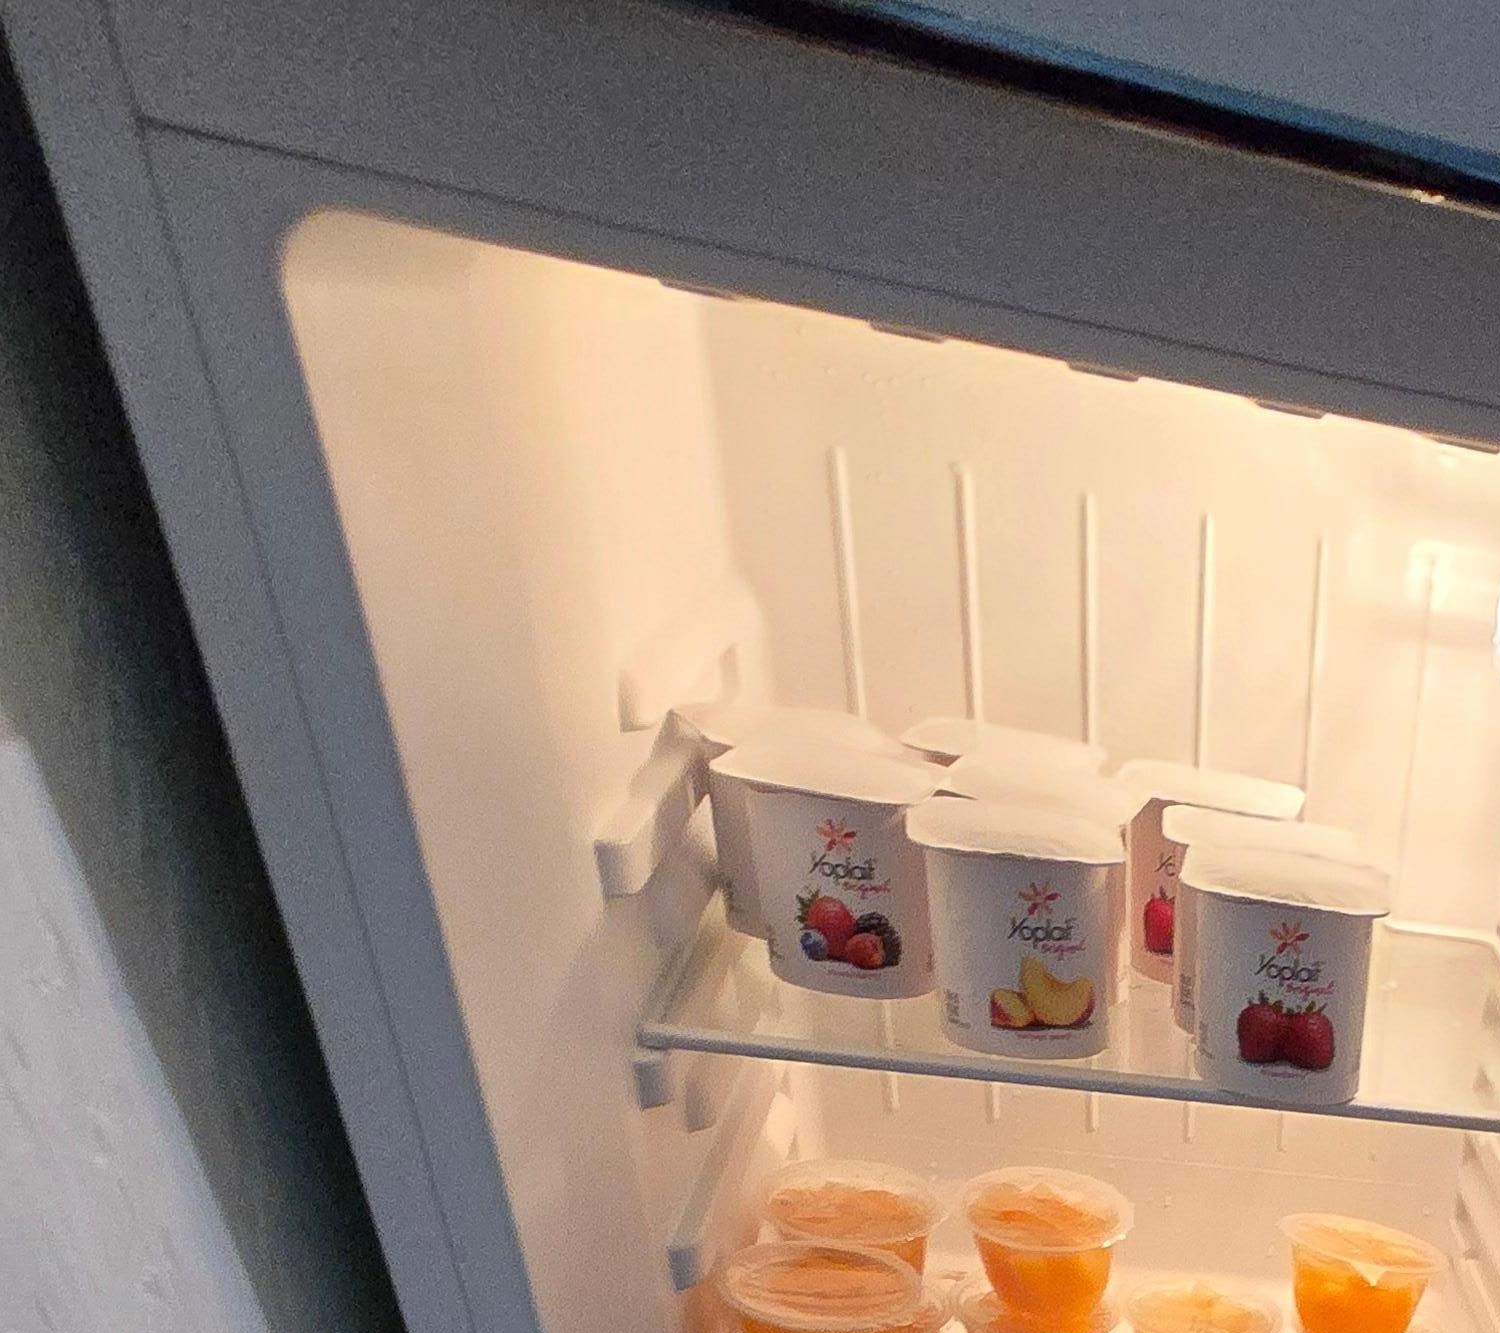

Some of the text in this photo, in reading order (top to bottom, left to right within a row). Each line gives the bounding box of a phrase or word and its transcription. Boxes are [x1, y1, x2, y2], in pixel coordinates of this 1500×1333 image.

[809, 851, 876, 886] Yoplait
[1007, 913, 1076, 949] Yoplait
[1253, 953, 1327, 987] Yoplait
